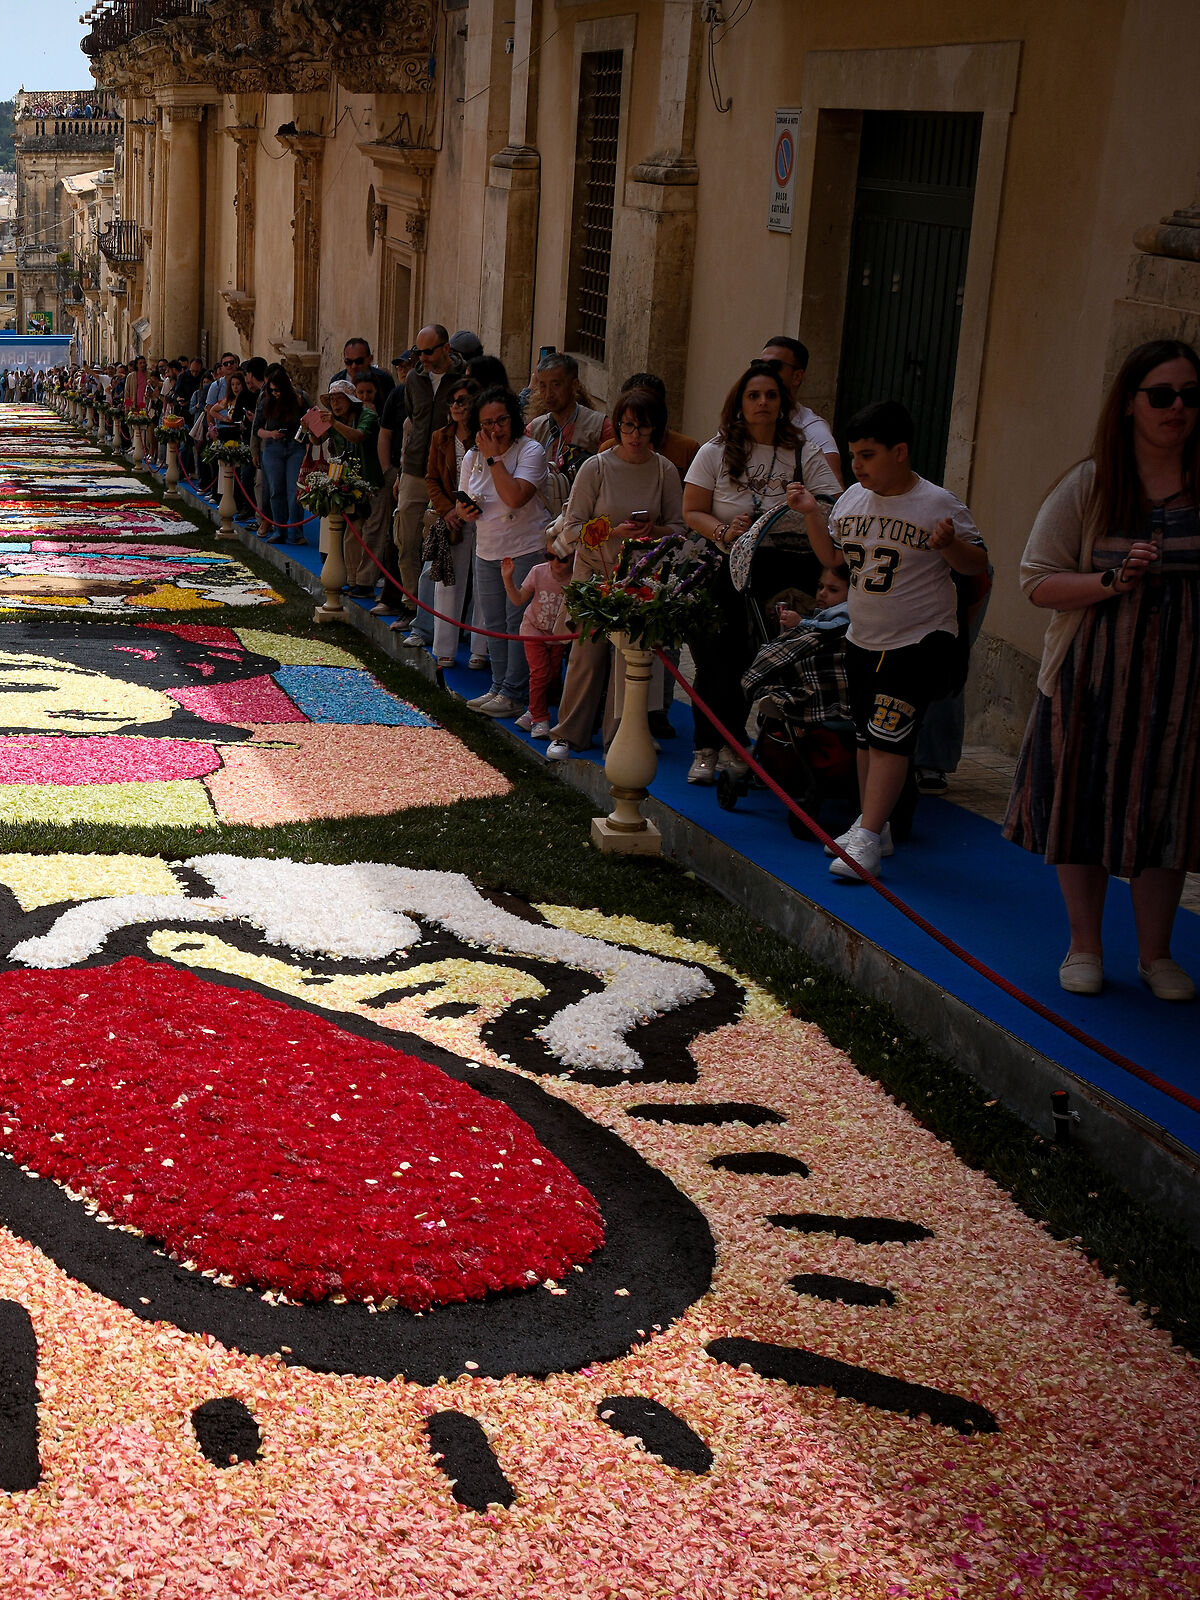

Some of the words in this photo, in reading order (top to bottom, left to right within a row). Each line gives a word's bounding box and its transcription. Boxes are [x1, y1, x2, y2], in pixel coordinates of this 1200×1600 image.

[775, 191, 788, 201] passo
[771, 202, 790, 215] carrabile
[877, 516, 932, 551] YORK
[872, 706, 901, 732] 23
